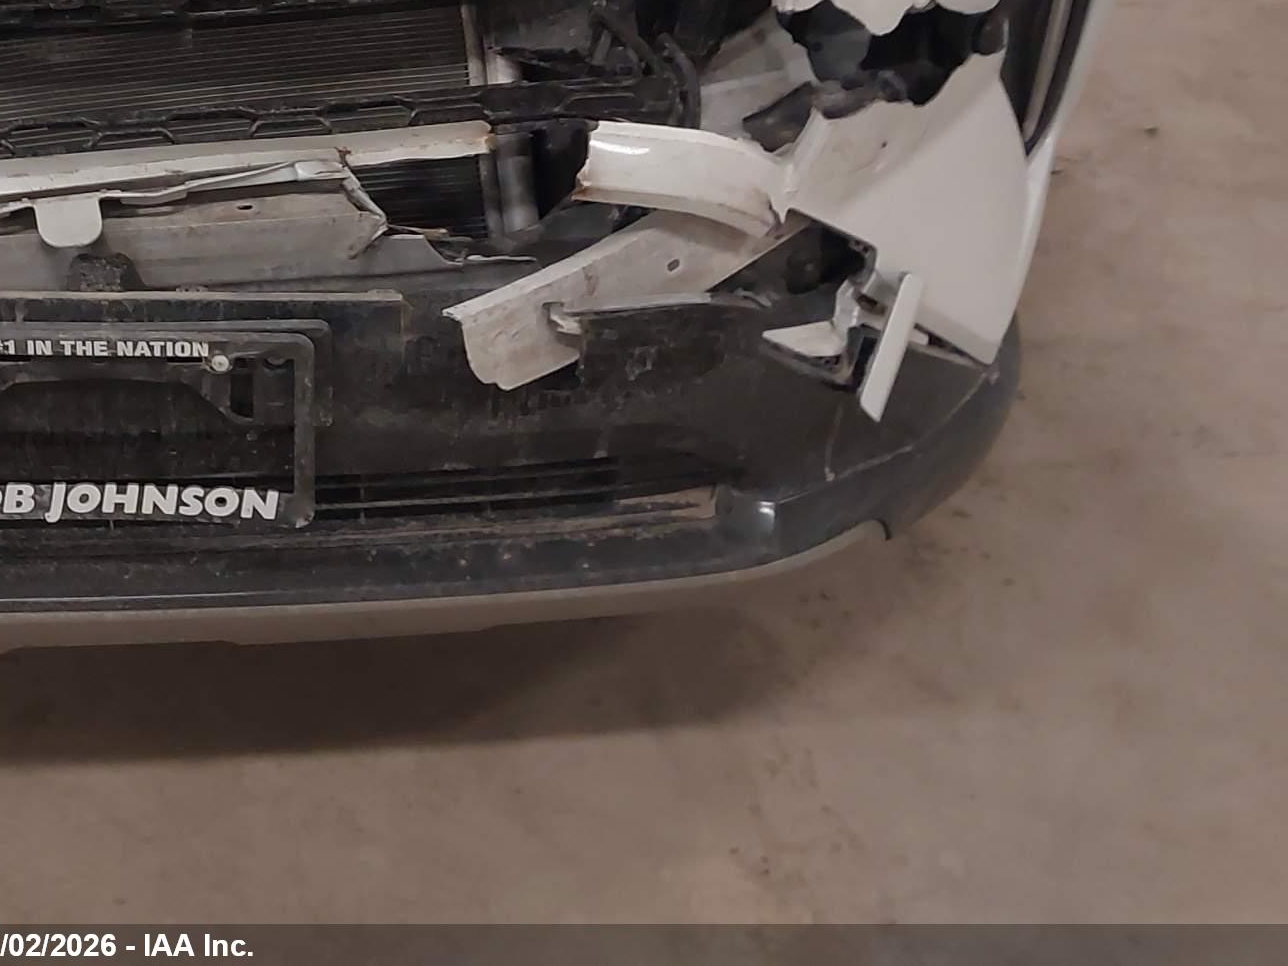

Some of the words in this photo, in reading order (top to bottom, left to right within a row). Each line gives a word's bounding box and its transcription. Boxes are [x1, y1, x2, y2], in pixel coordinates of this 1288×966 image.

[27, 340, 53, 355] IN
[61, 340, 109, 357] THE
[117, 341, 210, 359] NATION
[44, 481, 280, 524] JOHNSON
